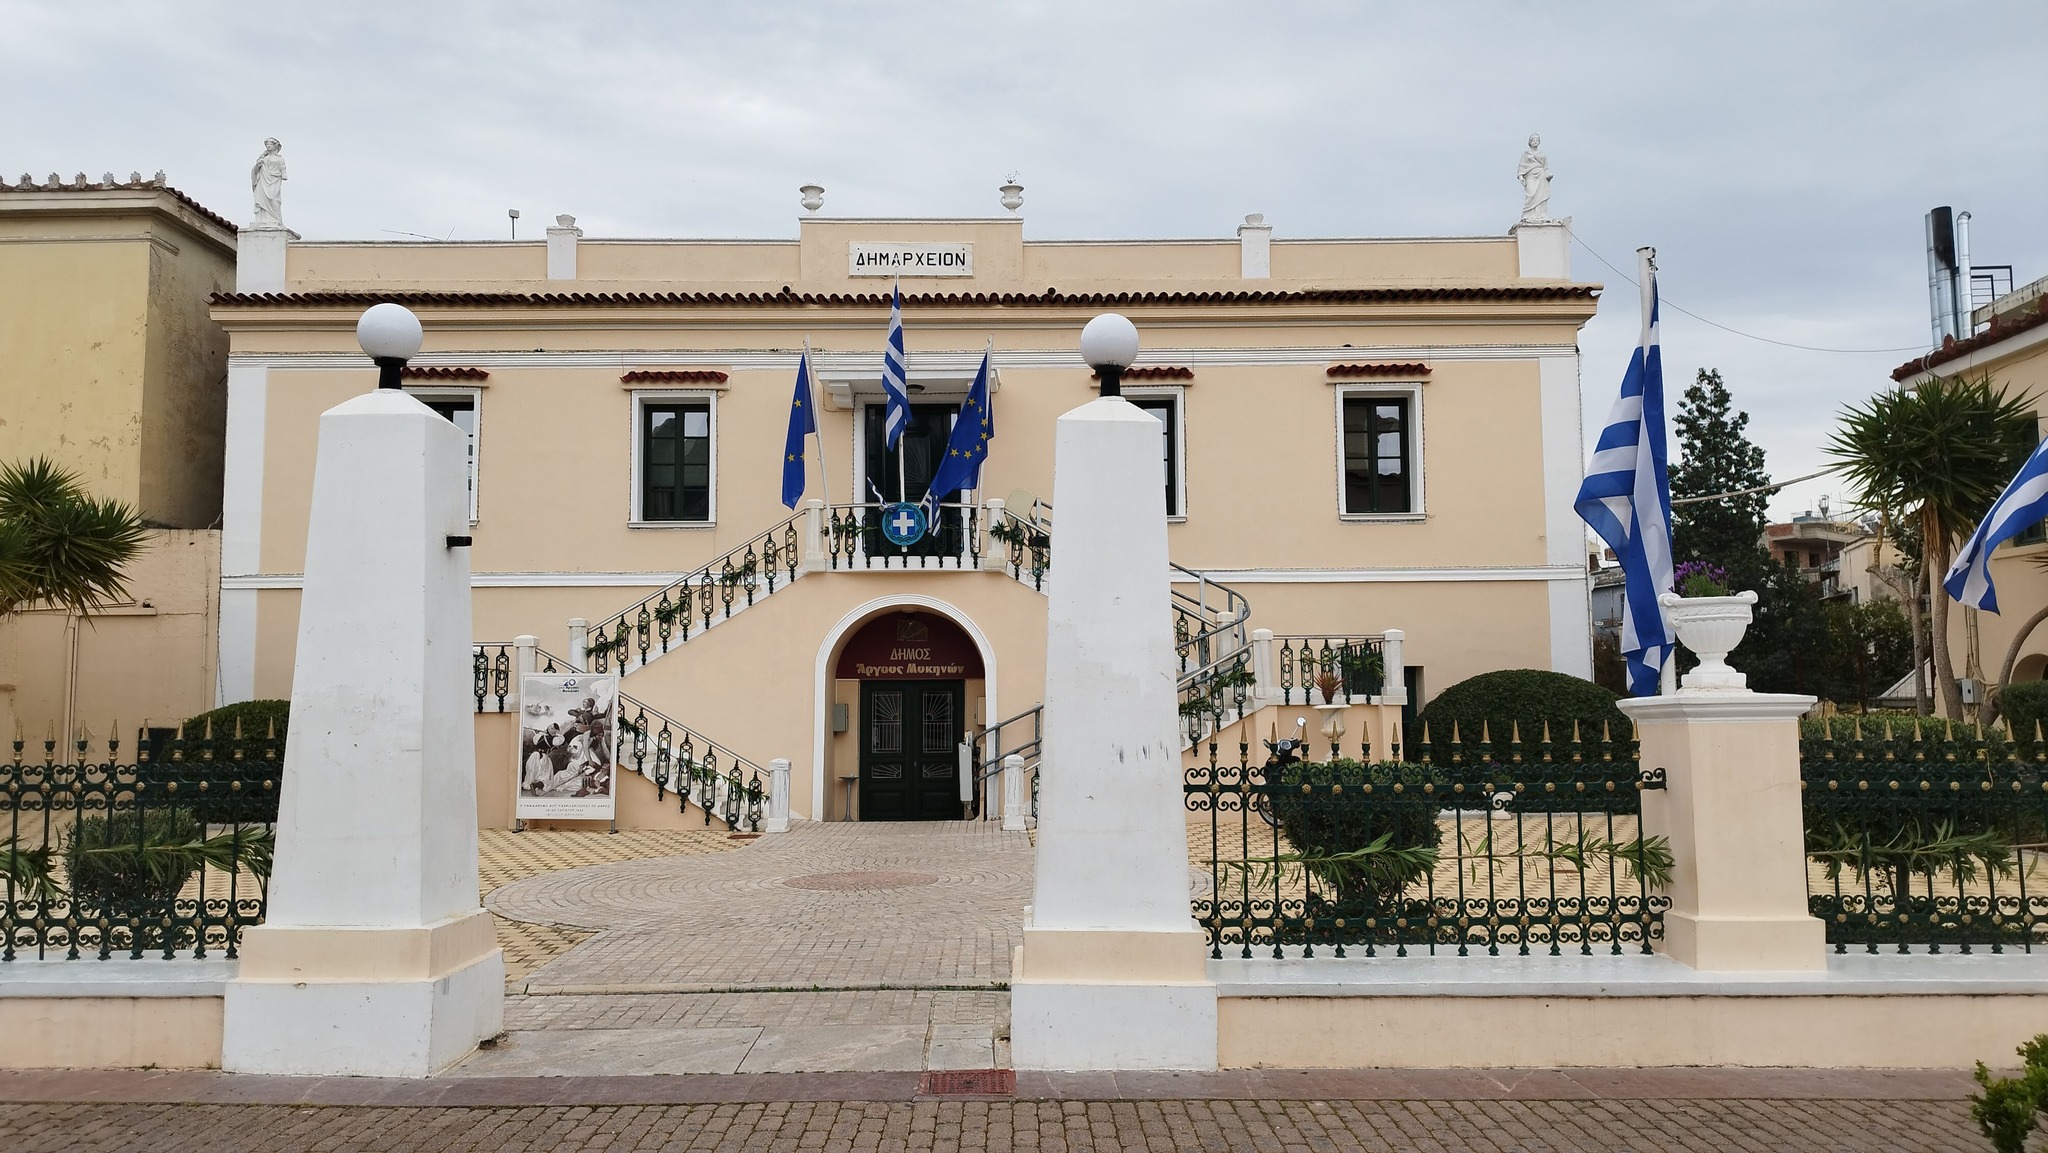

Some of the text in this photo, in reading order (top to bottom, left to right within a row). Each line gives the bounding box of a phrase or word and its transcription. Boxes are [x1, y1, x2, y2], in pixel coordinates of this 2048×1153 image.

[856, 252, 966, 266] ΔΗΜΑΡΧΕΙΟΝ
[890, 648, 931, 660] ΔΗΜΟΣ
[856, 663, 964, 677] Άργους Μυκηνών
